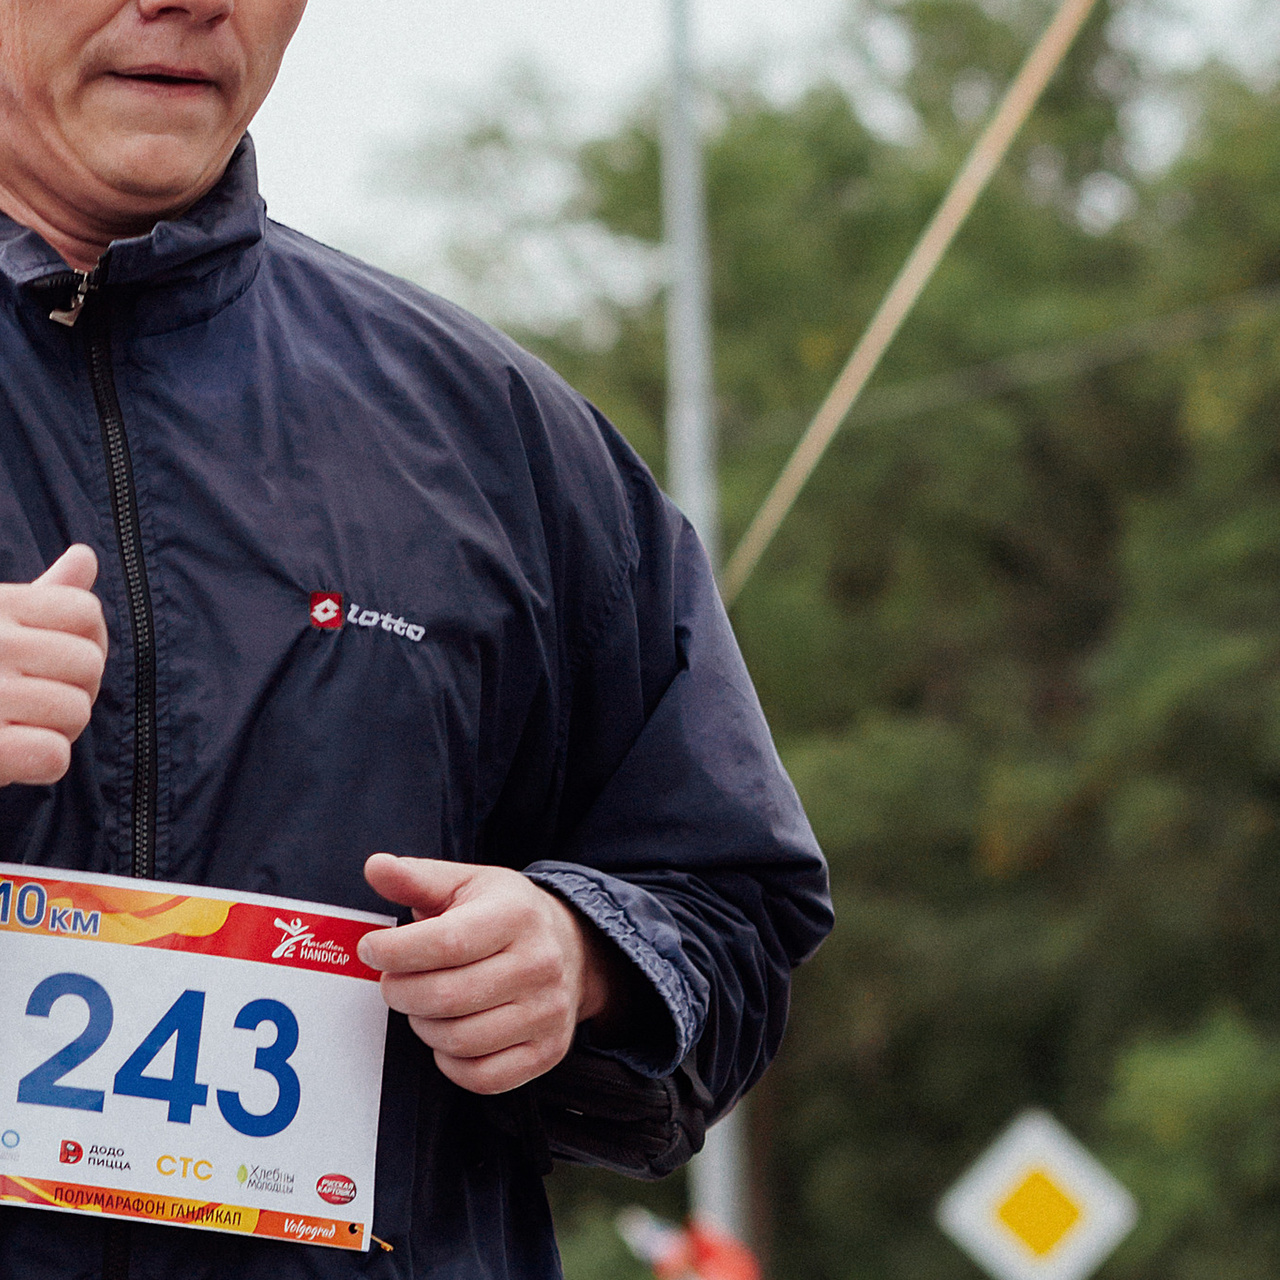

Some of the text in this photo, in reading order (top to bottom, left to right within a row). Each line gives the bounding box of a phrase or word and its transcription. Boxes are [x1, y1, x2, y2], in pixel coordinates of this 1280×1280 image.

[300, 947, 350, 965] HANDICAP
[16, 972, 301, 1137] 243
[88, 1157, 131, 1171] ПИЦЦА
[156, 1155, 213, 1181] СТС
[54, 1187, 242, 1226] ПОЛУМАРАФОН ГАНДИКАП
[283, 1218, 337, 1240] Volgograd
